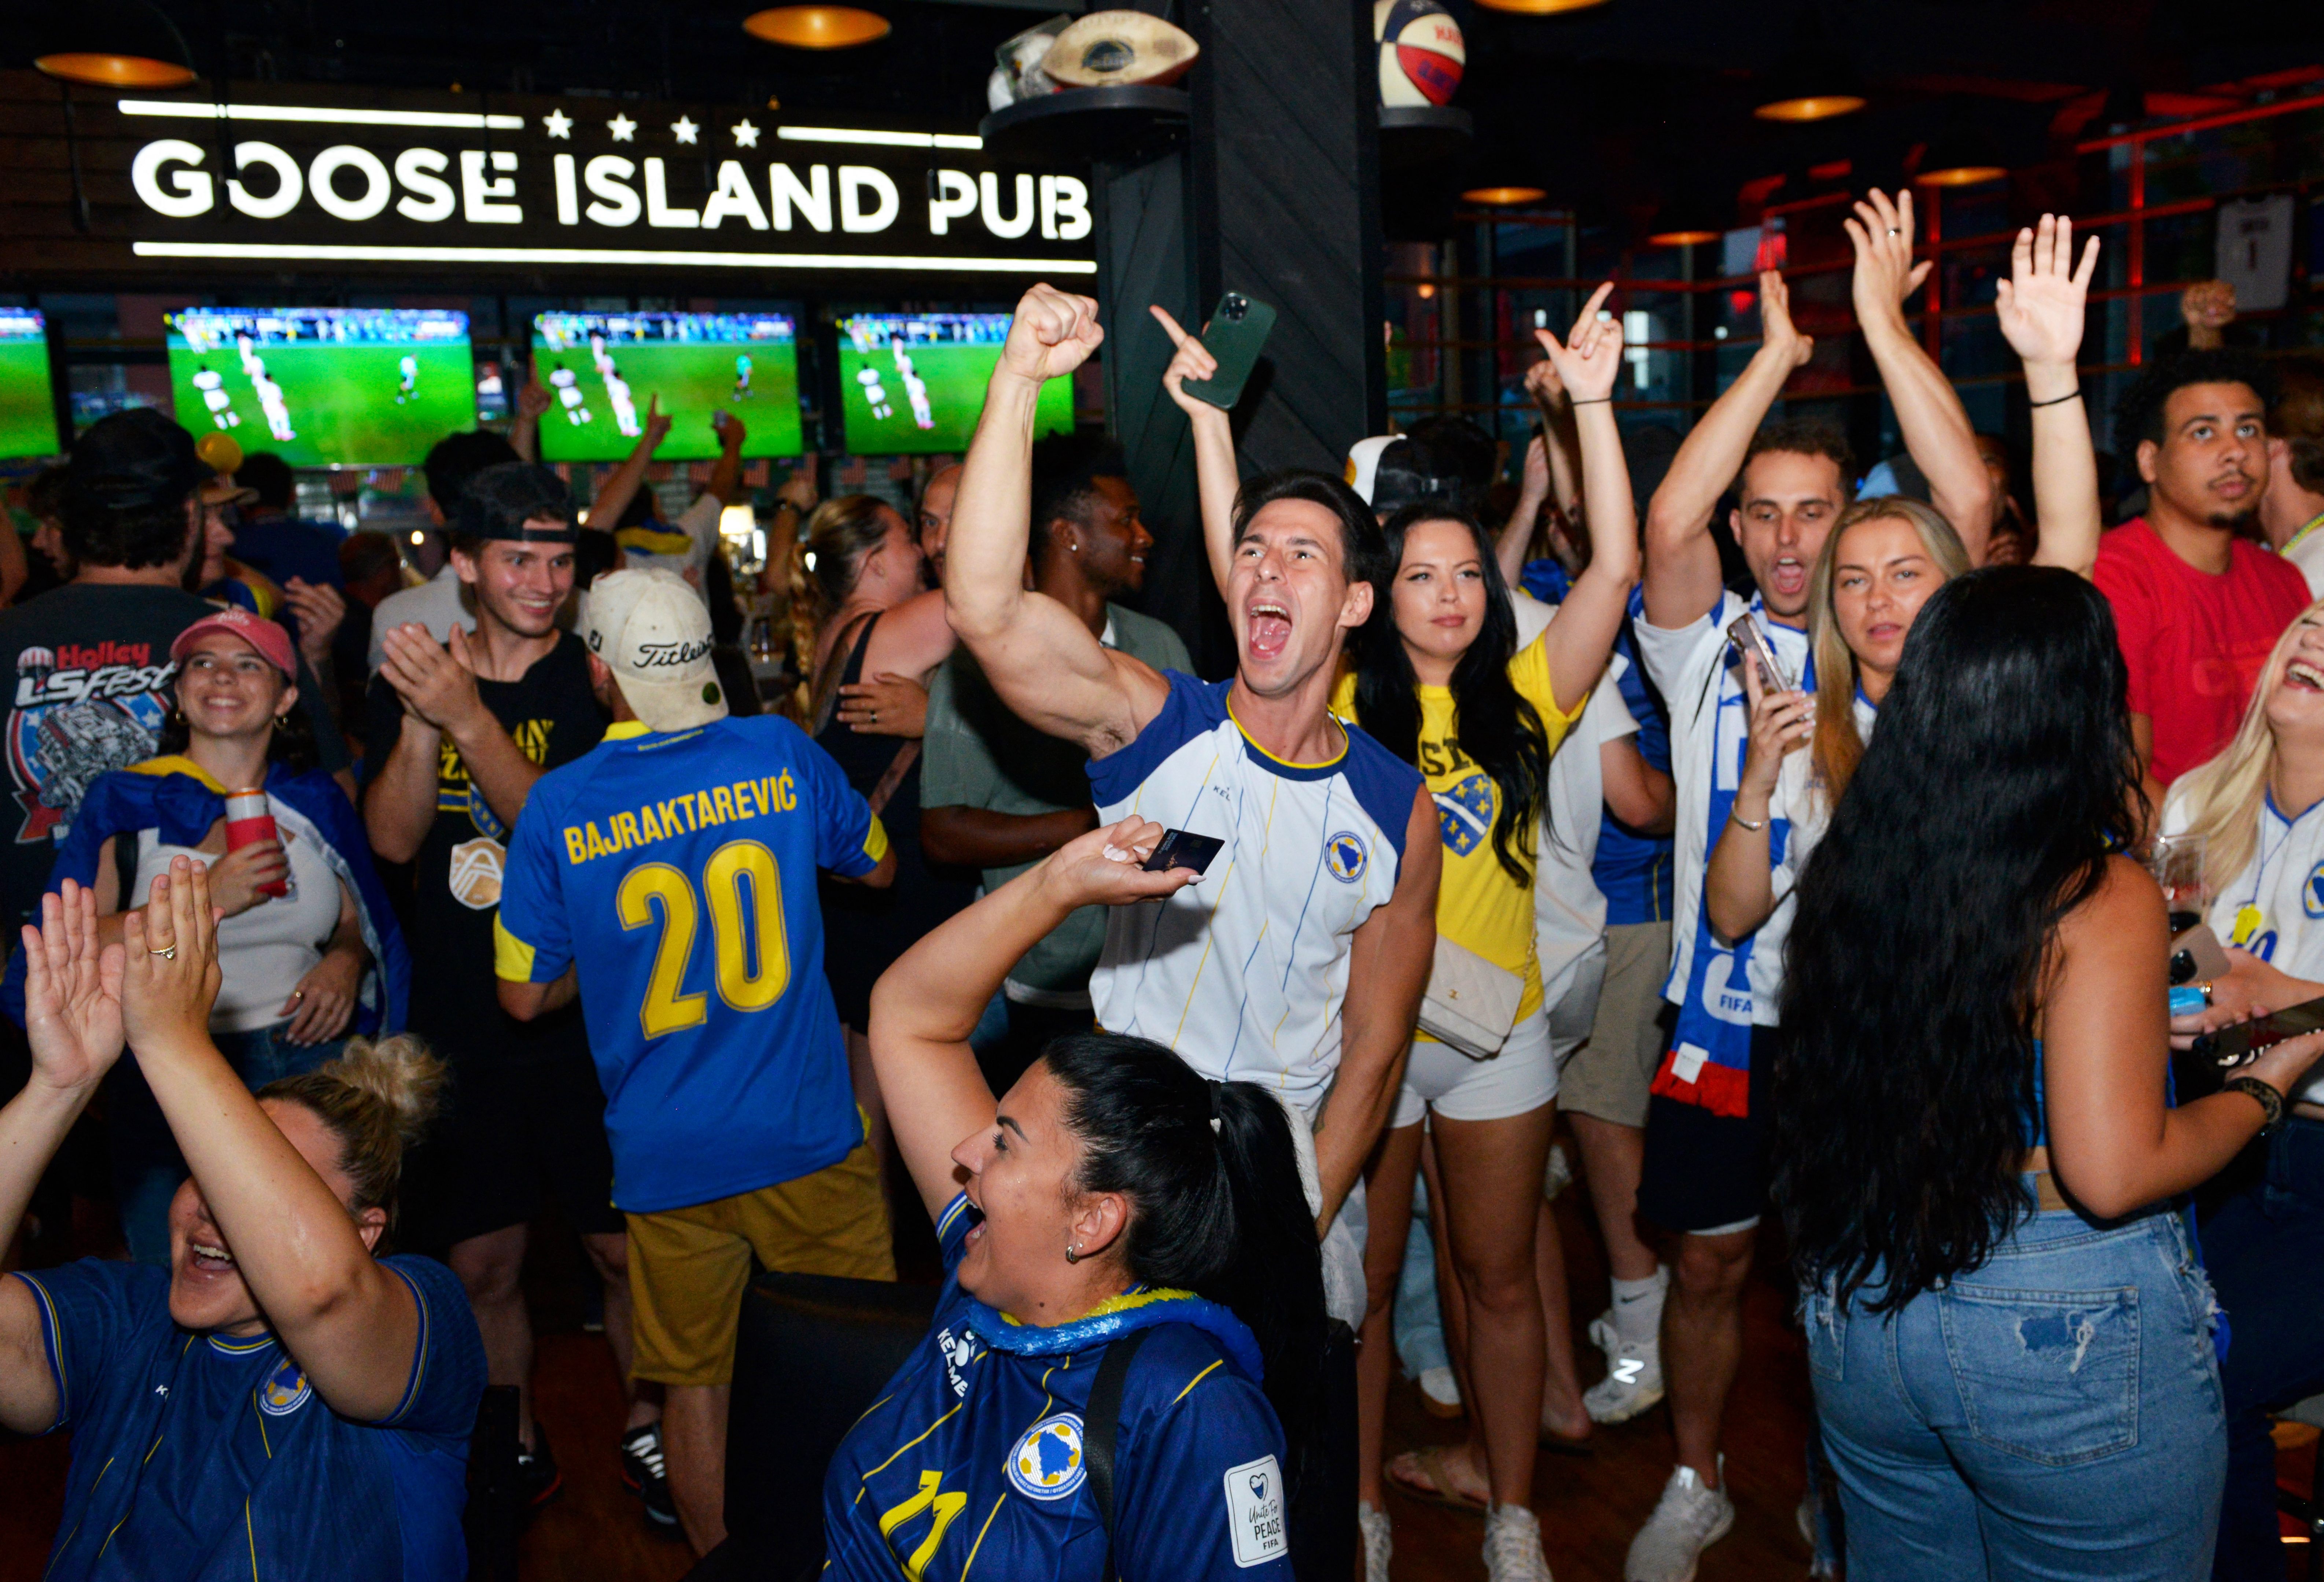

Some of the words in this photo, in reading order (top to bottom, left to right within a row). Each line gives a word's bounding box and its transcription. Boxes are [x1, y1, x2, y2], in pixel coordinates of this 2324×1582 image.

[132, 139, 523, 224] GOOSE
[554, 154, 899, 233] ISLAND
[929, 170, 1092, 240] PUB
[57, 640, 151, 672] Holley
[1213, 785, 1230, 801] KEL
[563, 767, 797, 865] BAJRAKTAREVIĆ
[616, 838, 791, 1041] 20
[1720, 994, 1753, 1012] FIFA
[937, 1327, 968, 1397] KELME
[1249, 1504, 1269, 1524] Unite
[1254, 1518, 1281, 1541] PEACE
[1263, 1539, 1278, 1550] FIFA
